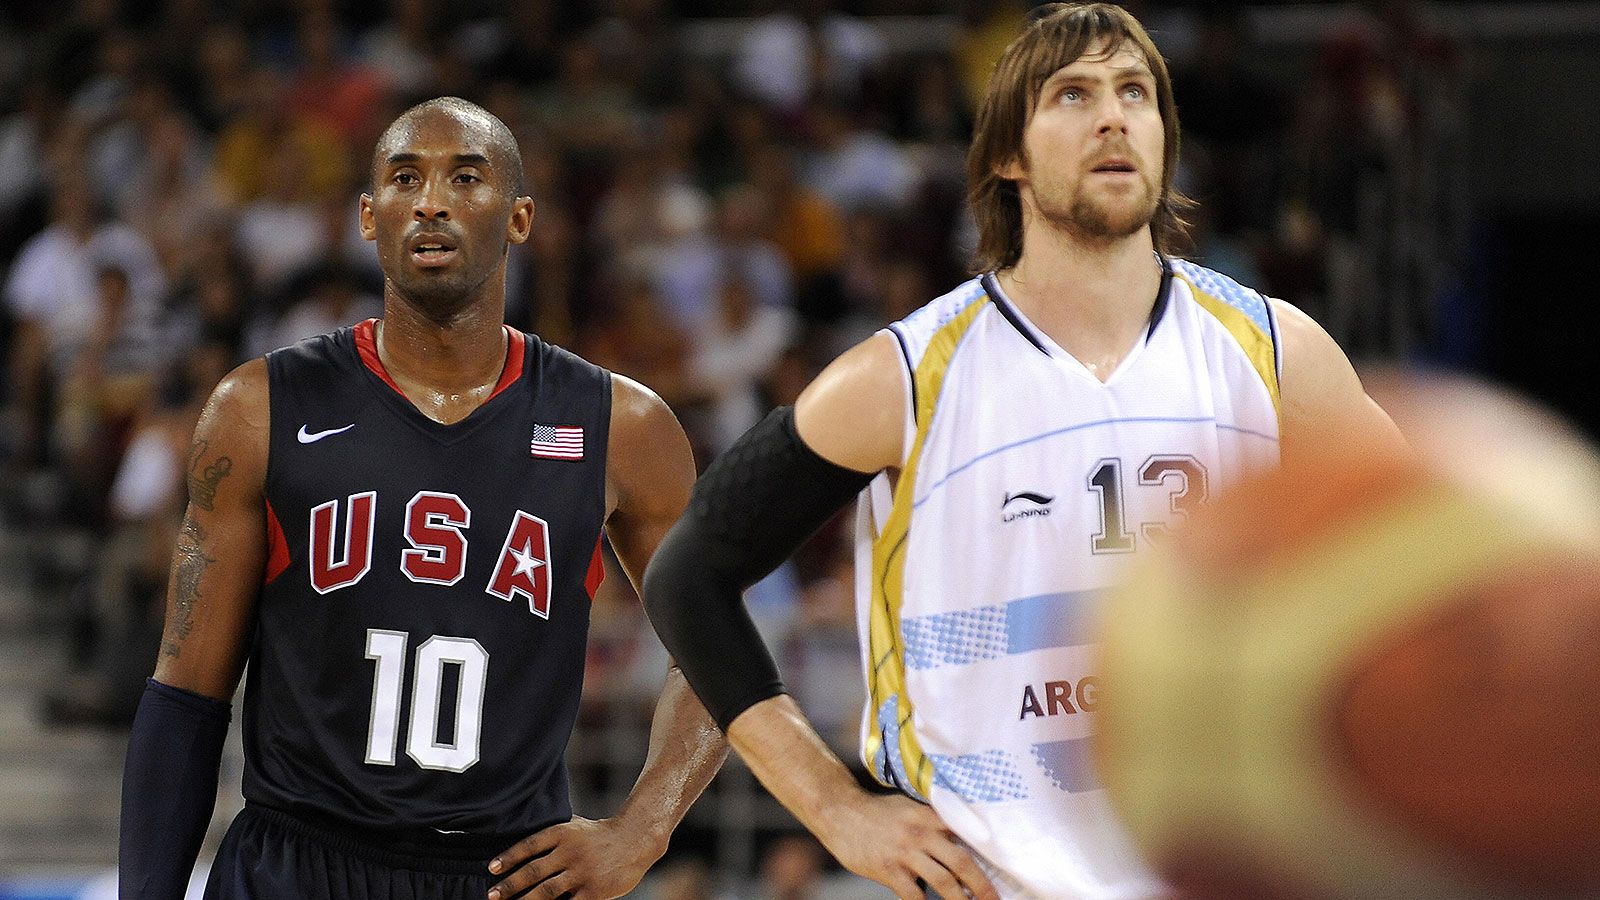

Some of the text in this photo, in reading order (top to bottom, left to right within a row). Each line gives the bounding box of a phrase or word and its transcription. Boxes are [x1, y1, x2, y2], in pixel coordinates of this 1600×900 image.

[310, 491, 552, 620] USA
[1087, 454, 1209, 555] 13
[364, 628, 490, 773] 10
